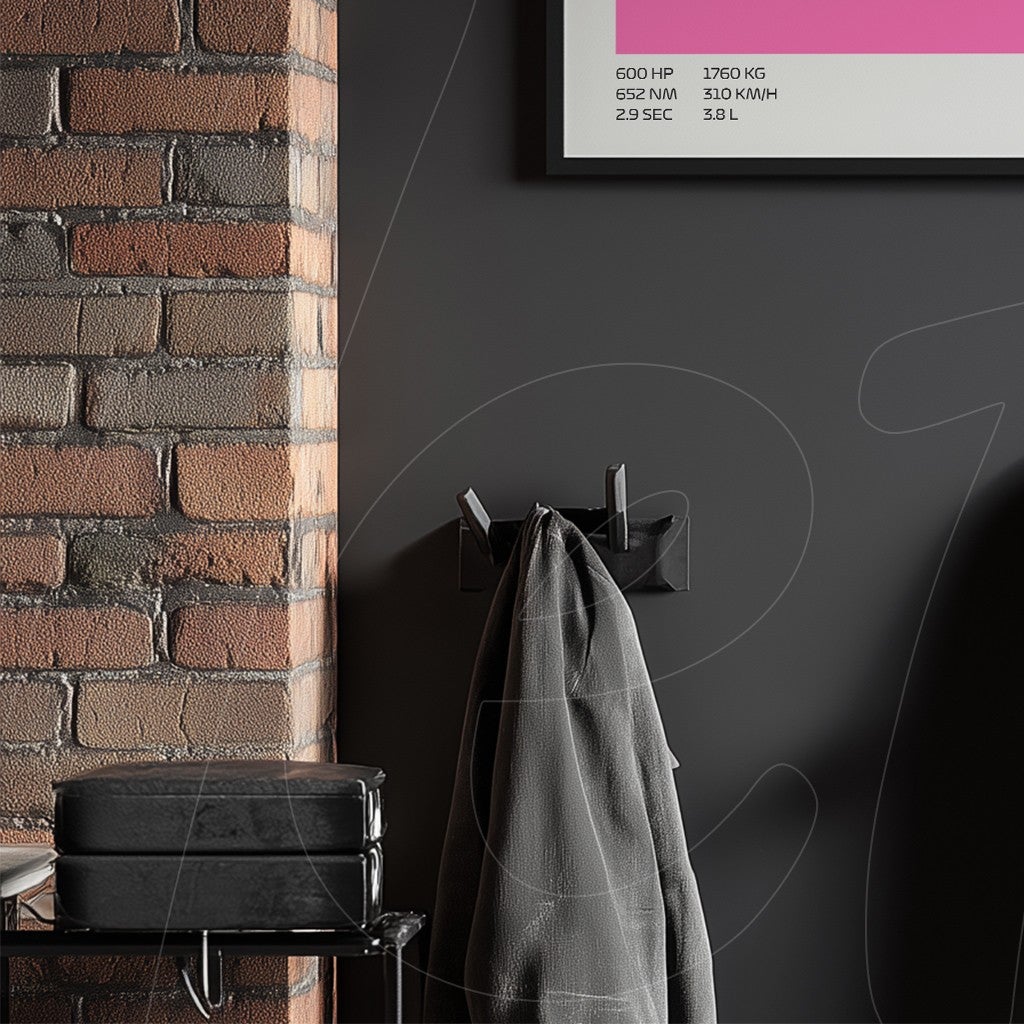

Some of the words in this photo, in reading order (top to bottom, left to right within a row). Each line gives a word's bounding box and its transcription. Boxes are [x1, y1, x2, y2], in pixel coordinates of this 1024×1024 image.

[615, 67, 648, 80] 600
[651, 67, 674, 80] HP
[703, 67, 741, 80] 1760
[744, 67, 766, 80] KG
[615, 88, 646, 101] 652
[649, 87, 678, 101] NM
[703, 87, 732, 101] 310
[735, 87, 778, 102] KM/H
[615, 108, 639, 121] 2.9
[642, 108, 673, 121] SEC
[703, 108, 726, 121] 3.8
[729, 108, 739, 121] L
